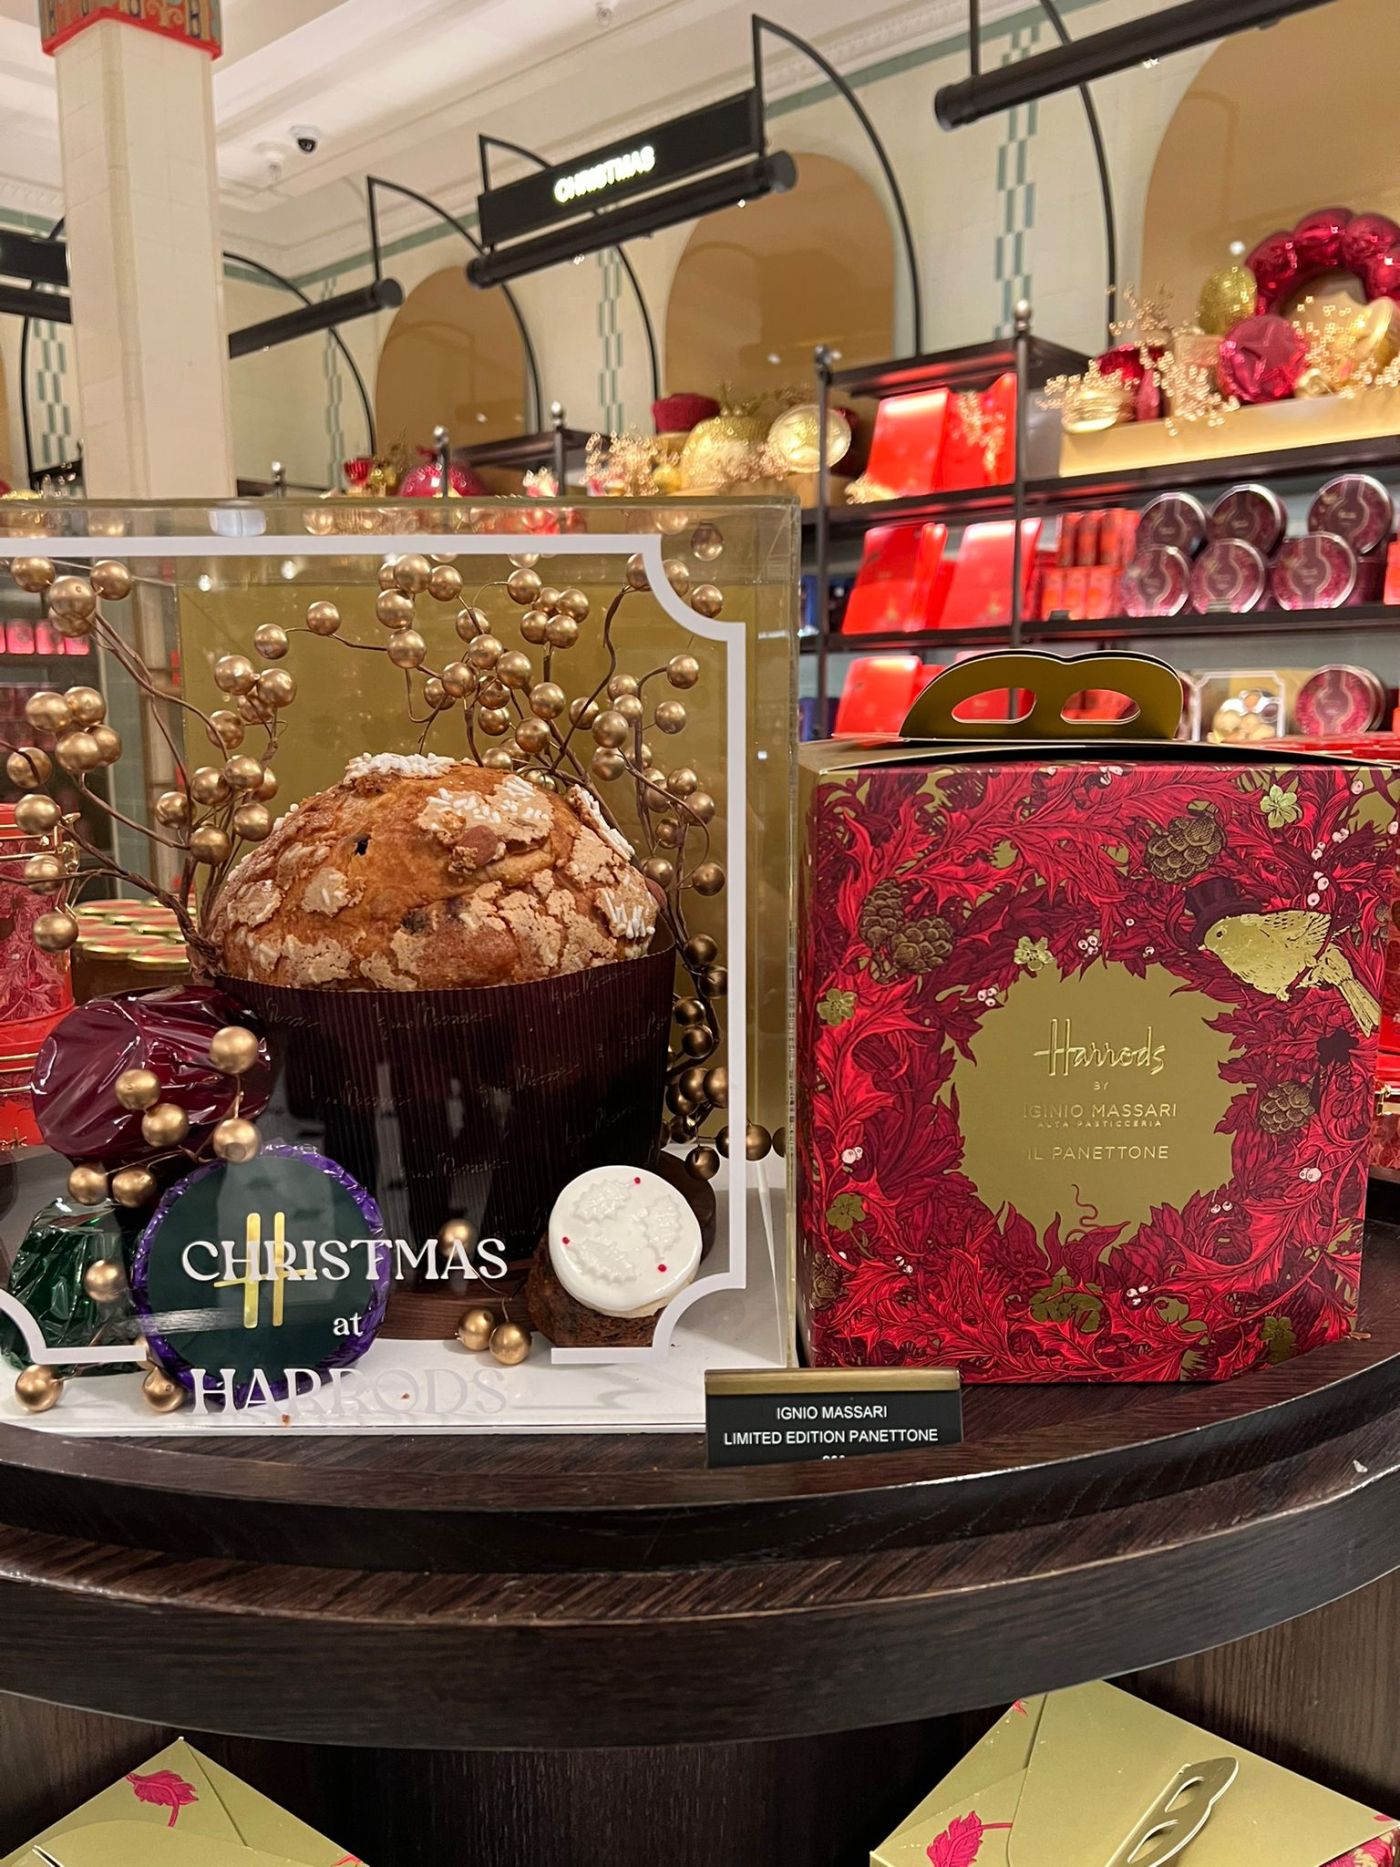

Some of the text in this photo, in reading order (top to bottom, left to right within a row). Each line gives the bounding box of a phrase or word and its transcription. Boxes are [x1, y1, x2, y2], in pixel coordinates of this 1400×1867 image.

[1033, 1018, 1166, 1077] Harrods
[1023, 1103, 1177, 1118] IGINIO MASSARI
[1028, 1145, 1169, 1160] IL PANETTONE
[181, 1238, 508, 1282] CHRISTMAS
[332, 1311, 364, 1337] at
[190, 1367, 509, 1417] HARRODS
[776, 1404, 888, 1421] IGNIO MASSARI
[723, 1428, 939, 1446] LIMITED EDITION PANETTONE
